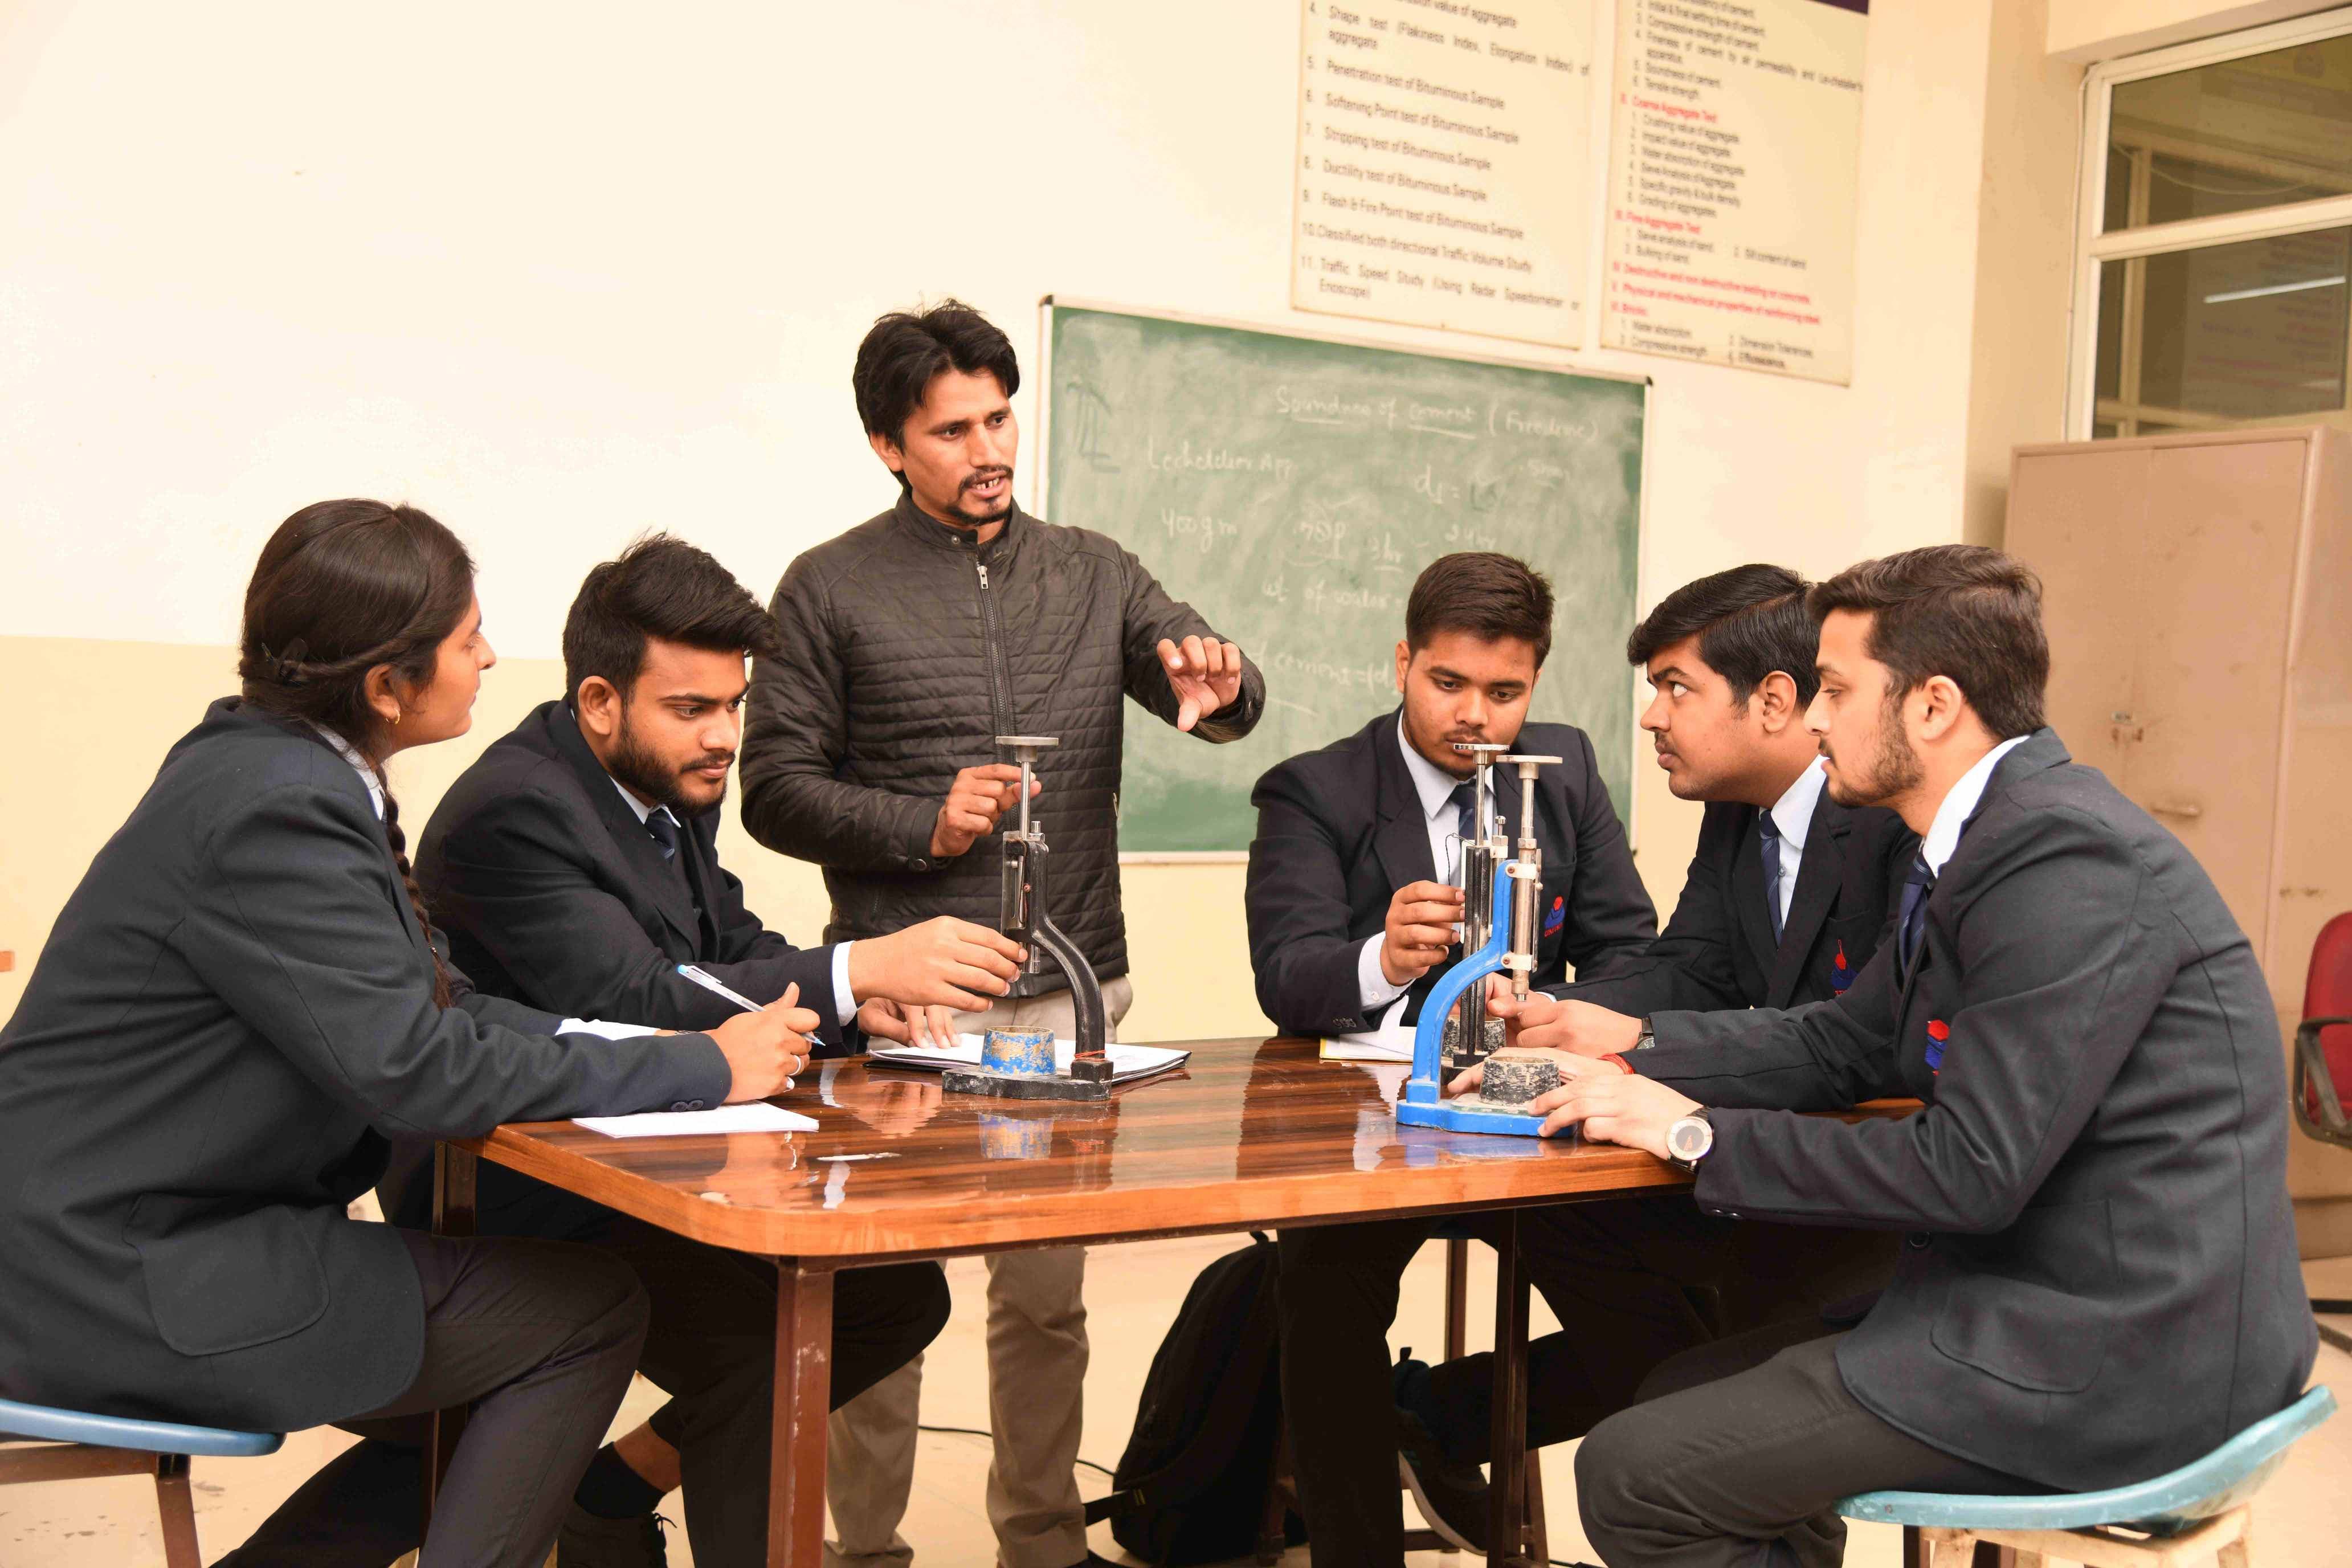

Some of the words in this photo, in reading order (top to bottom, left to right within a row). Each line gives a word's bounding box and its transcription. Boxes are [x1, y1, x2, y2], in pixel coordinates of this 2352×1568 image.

[1329, 6, 1359, 24] Shape
[1369, 17, 1387, 30] test
[1490, 43, 1536, 63] Elongation
[1329, 30, 1377, 48] aggregate
[1472, 10, 1516, 27] aggregate
[1327, 59, 1381, 81] Penetration
[1384, 74, 1403, 87] test
[1415, 79, 1468, 101] Bituminous
[1471, 91, 1504, 109] Sample
[1326, 92, 1372, 117] Softening
[1374, 103, 1399, 119] Point
[1400, 111, 1418, 122] test
[1431, 115, 1483, 136] Bituminous
[1485, 126, 1518, 143] Sample
[1325, 126, 1368, 149] Stripping
[1370, 137, 1389, 150] test
[1402, 141, 1454, 163] Bituminous
[1457, 152, 1491, 170] Sample
[1323, 159, 1363, 180] Ductility
[1366, 169, 1385, 182] test
[1397, 173, 1449, 194] Bituminous
[1452, 183, 1487, 201] Sample
[1322, 192, 1348, 207] Flash
[1359, 198, 1378, 214] Fire
[1379, 202, 1403, 218] Point
[1405, 209, 1423, 222] test
[1436, 213, 1487, 232] Bituminous
[1491, 222, 1523, 239] Sample
[1317, 224, 1364, 244] Classified
[1366, 234, 1387, 247] both
[1390, 238, 1438, 256] directional
[1442, 246, 1468, 261] Traffic
[1471, 251, 1504, 267] Volume
[1506, 256, 1532, 272] Study
[1321, 258, 1349, 274] Traffic
[1358, 264, 1388, 280] Speed
[1397, 270, 1423, 287] Study
[1471, 282, 1496, 297] Radar
[1505, 288, 1563, 307] Speedometer
[1379, 396, 1397, 431] of
[1408, 402, 1478, 423] cement
